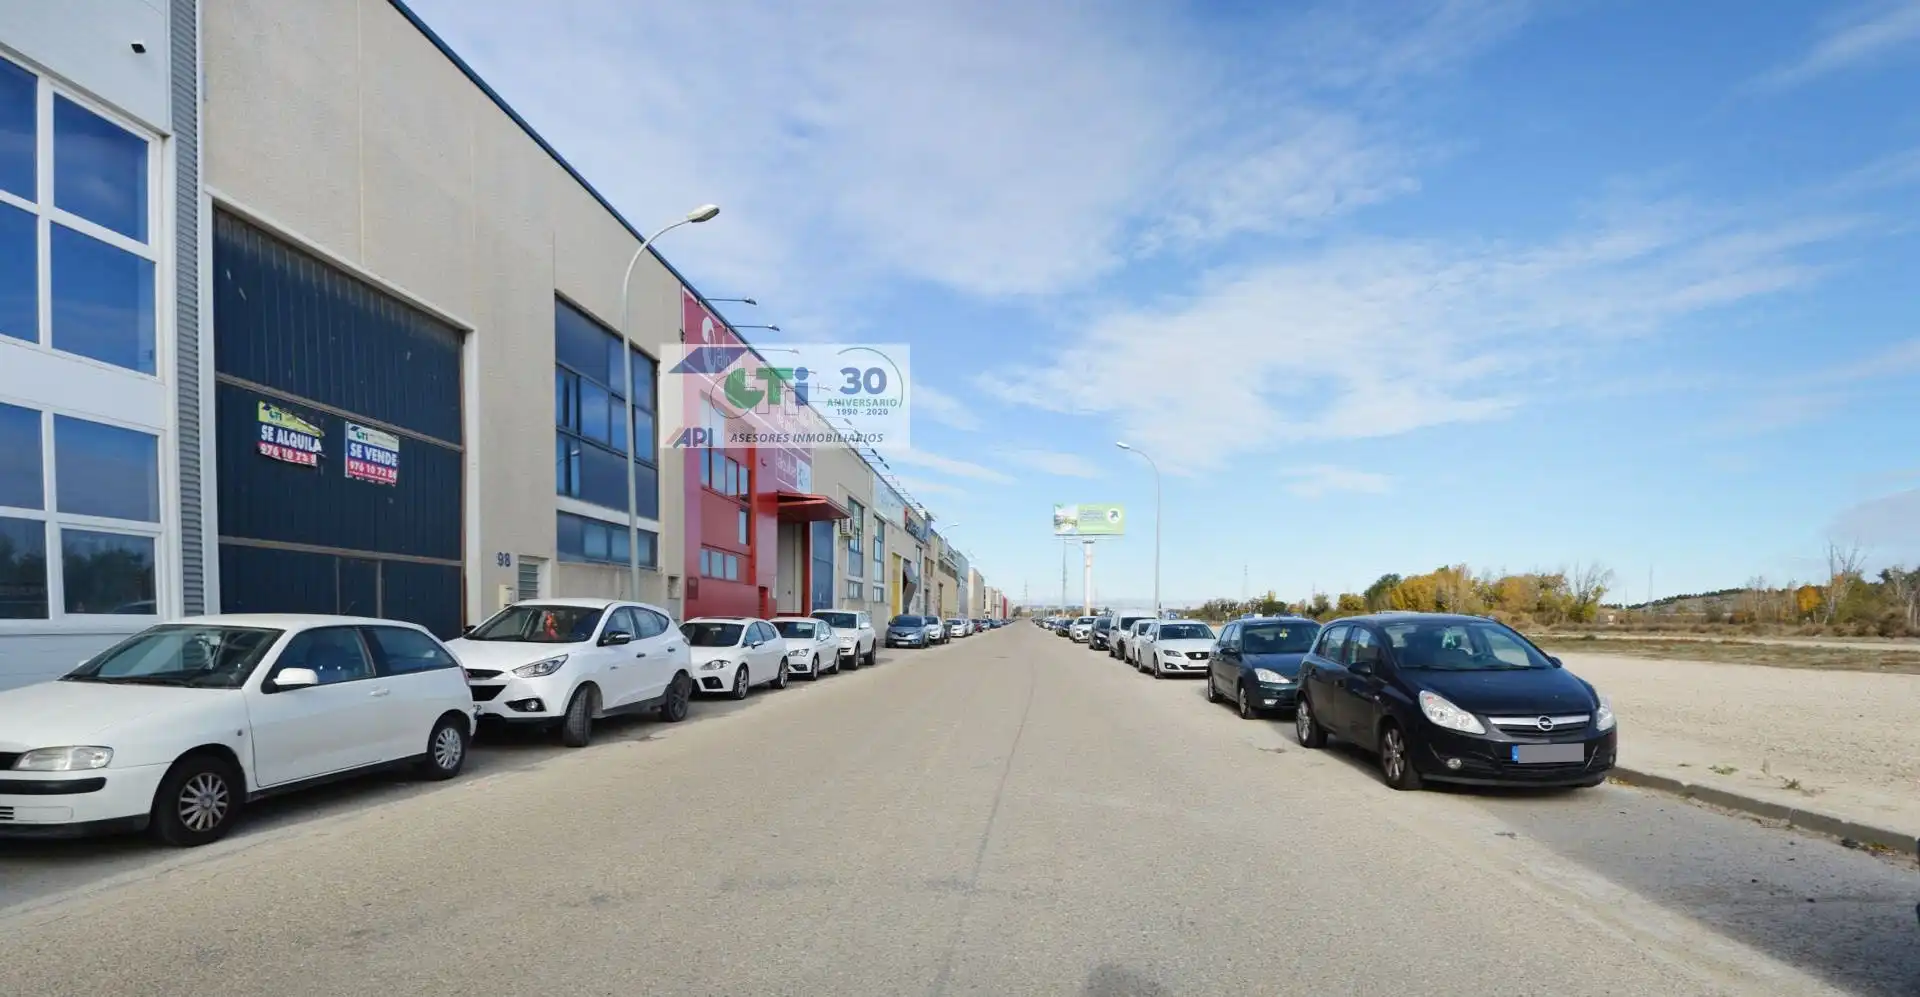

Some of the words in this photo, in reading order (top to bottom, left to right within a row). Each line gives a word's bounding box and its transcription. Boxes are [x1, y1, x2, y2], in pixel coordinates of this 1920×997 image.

[261, 424, 274, 442] SE
[276, 428, 322, 452] ALQUILA
[350, 442, 363, 459] SE
[364, 446, 398, 467] VENDE
[497, 551, 511, 567] 98
